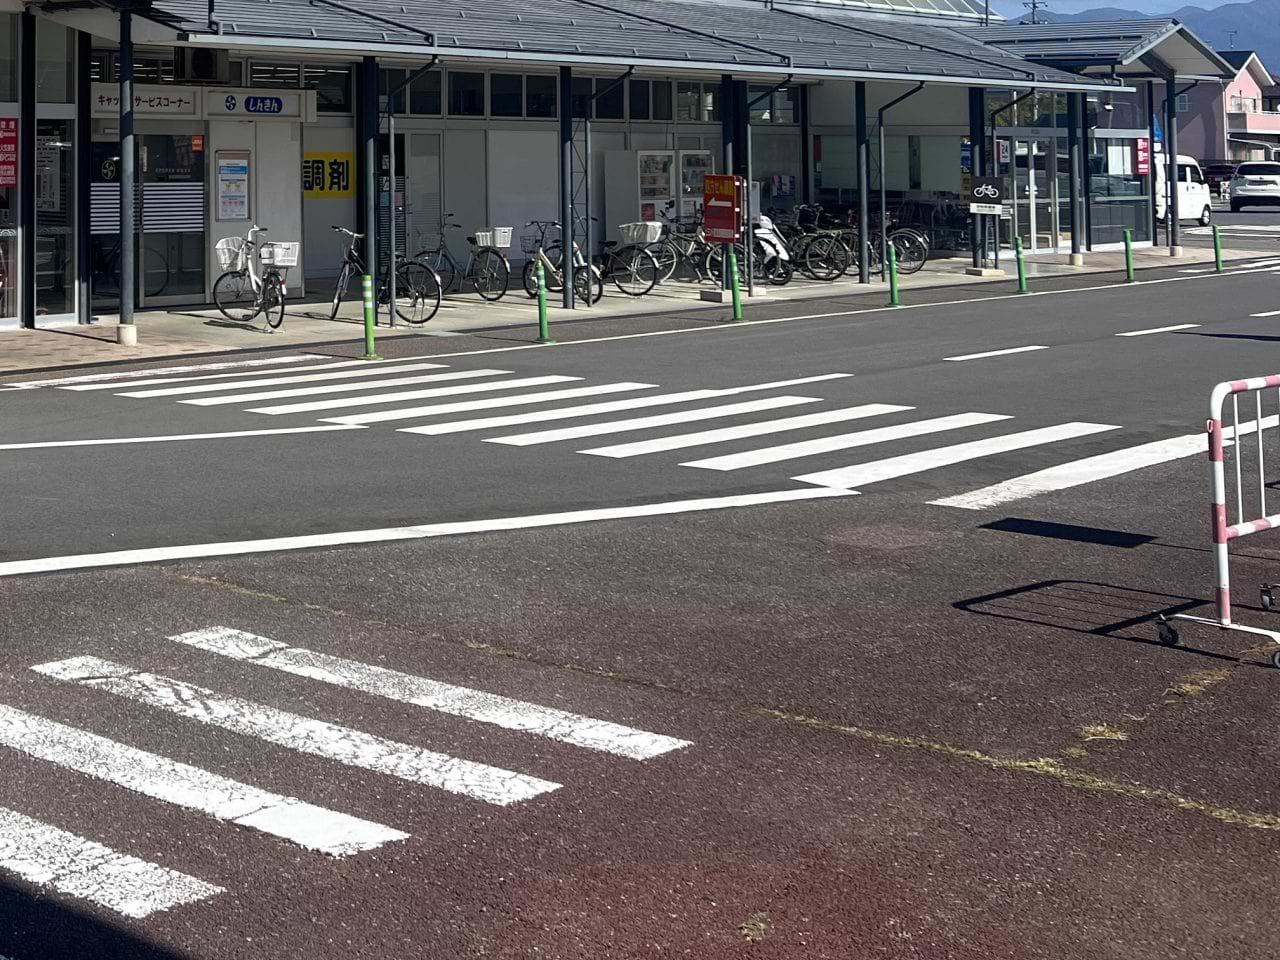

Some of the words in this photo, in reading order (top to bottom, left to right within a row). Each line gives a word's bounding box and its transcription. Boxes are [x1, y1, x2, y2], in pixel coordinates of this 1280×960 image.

[97, 94, 191, 109] キャッサービスコーナー
[248, 98, 279, 112] しんきん
[303, 159, 349, 191] 調剤
